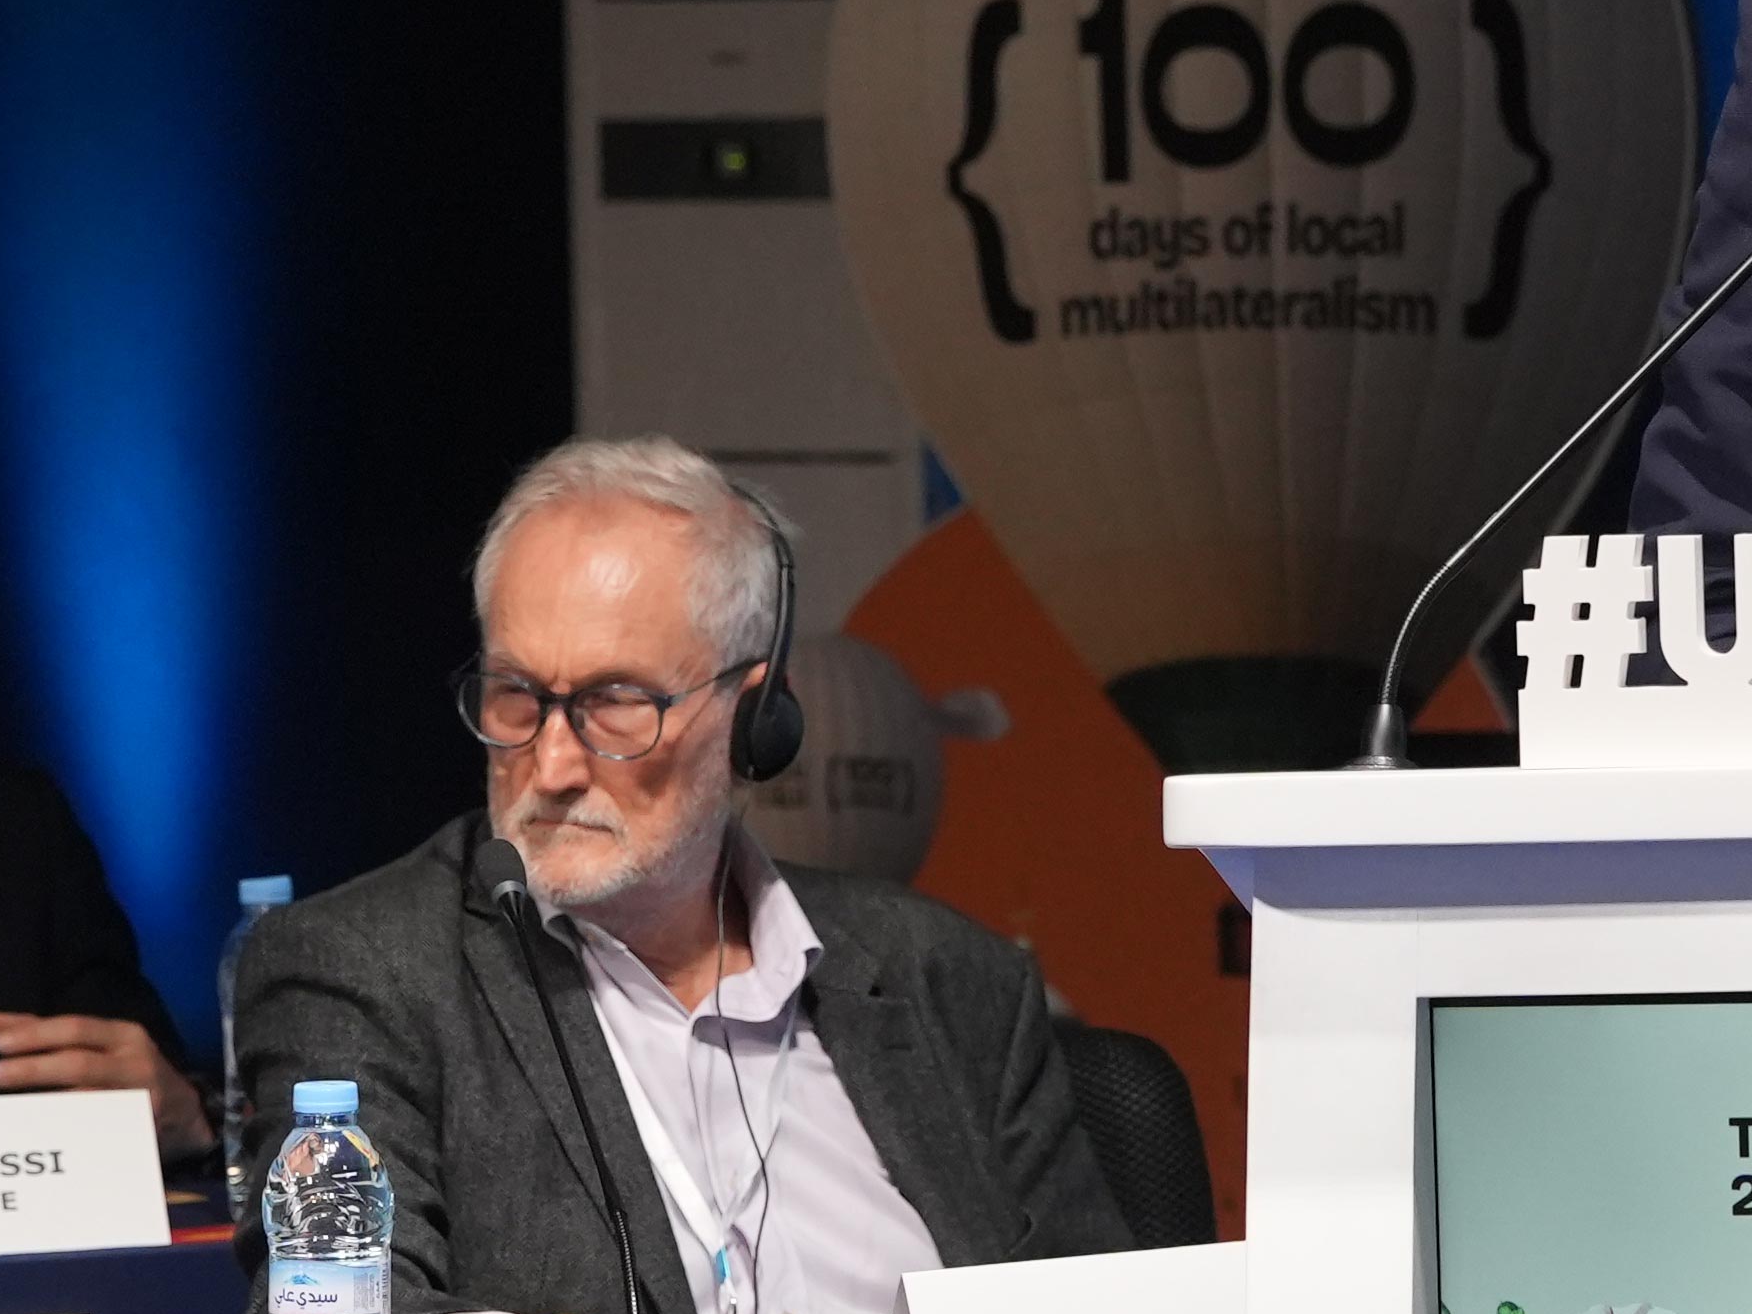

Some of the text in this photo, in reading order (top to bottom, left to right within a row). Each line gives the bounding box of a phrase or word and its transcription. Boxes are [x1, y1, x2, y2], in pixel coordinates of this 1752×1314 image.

[1089, 199, 1406, 270] days of local
[1059, 273, 1440, 337] multilateralism
[296, 1290, 338, 1310] سيدي
